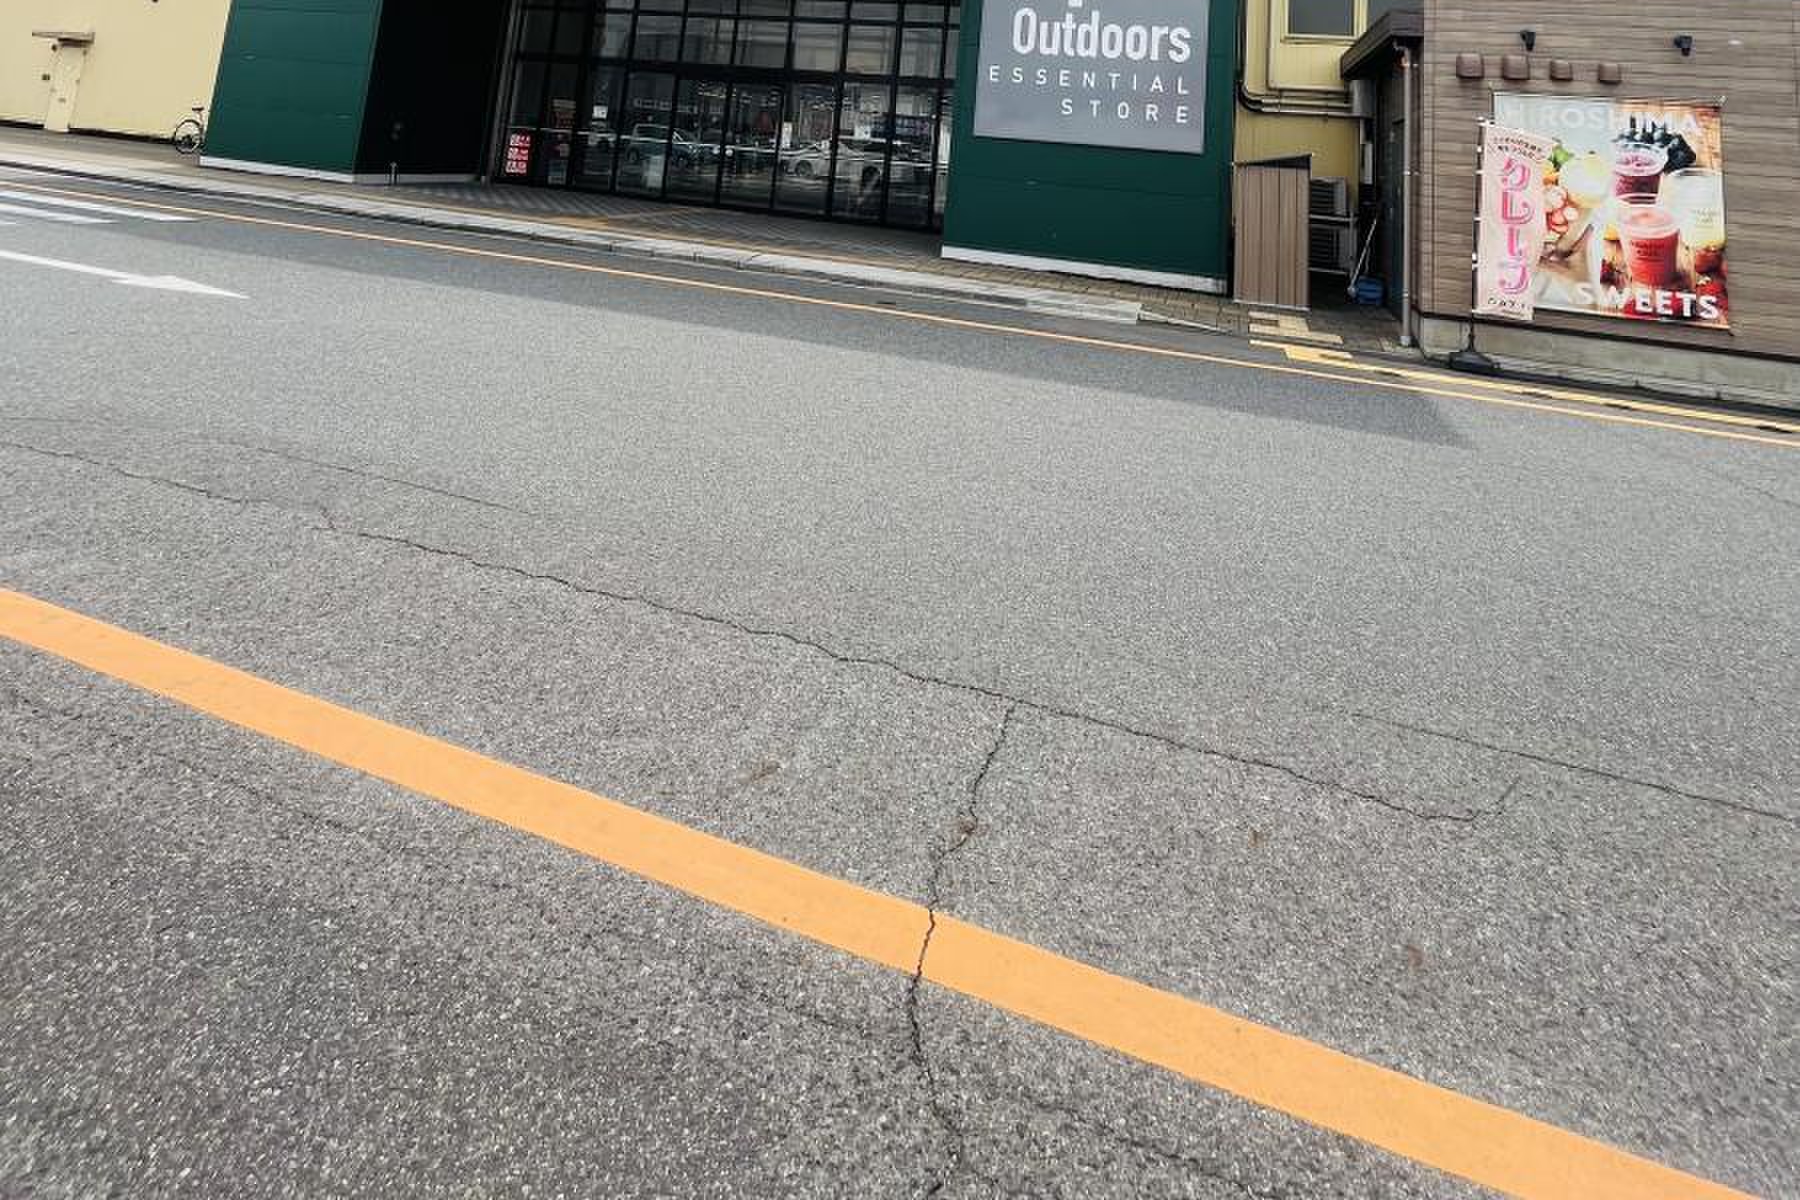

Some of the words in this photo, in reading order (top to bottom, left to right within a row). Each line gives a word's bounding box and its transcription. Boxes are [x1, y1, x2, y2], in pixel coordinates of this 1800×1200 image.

[1012, 7, 1191, 63] Outdoors
[989, 65, 1189, 95] ESSENTIAL
[1060, 98, 1188, 123] STORE
[1576, 283, 1719, 319] SWEETS
